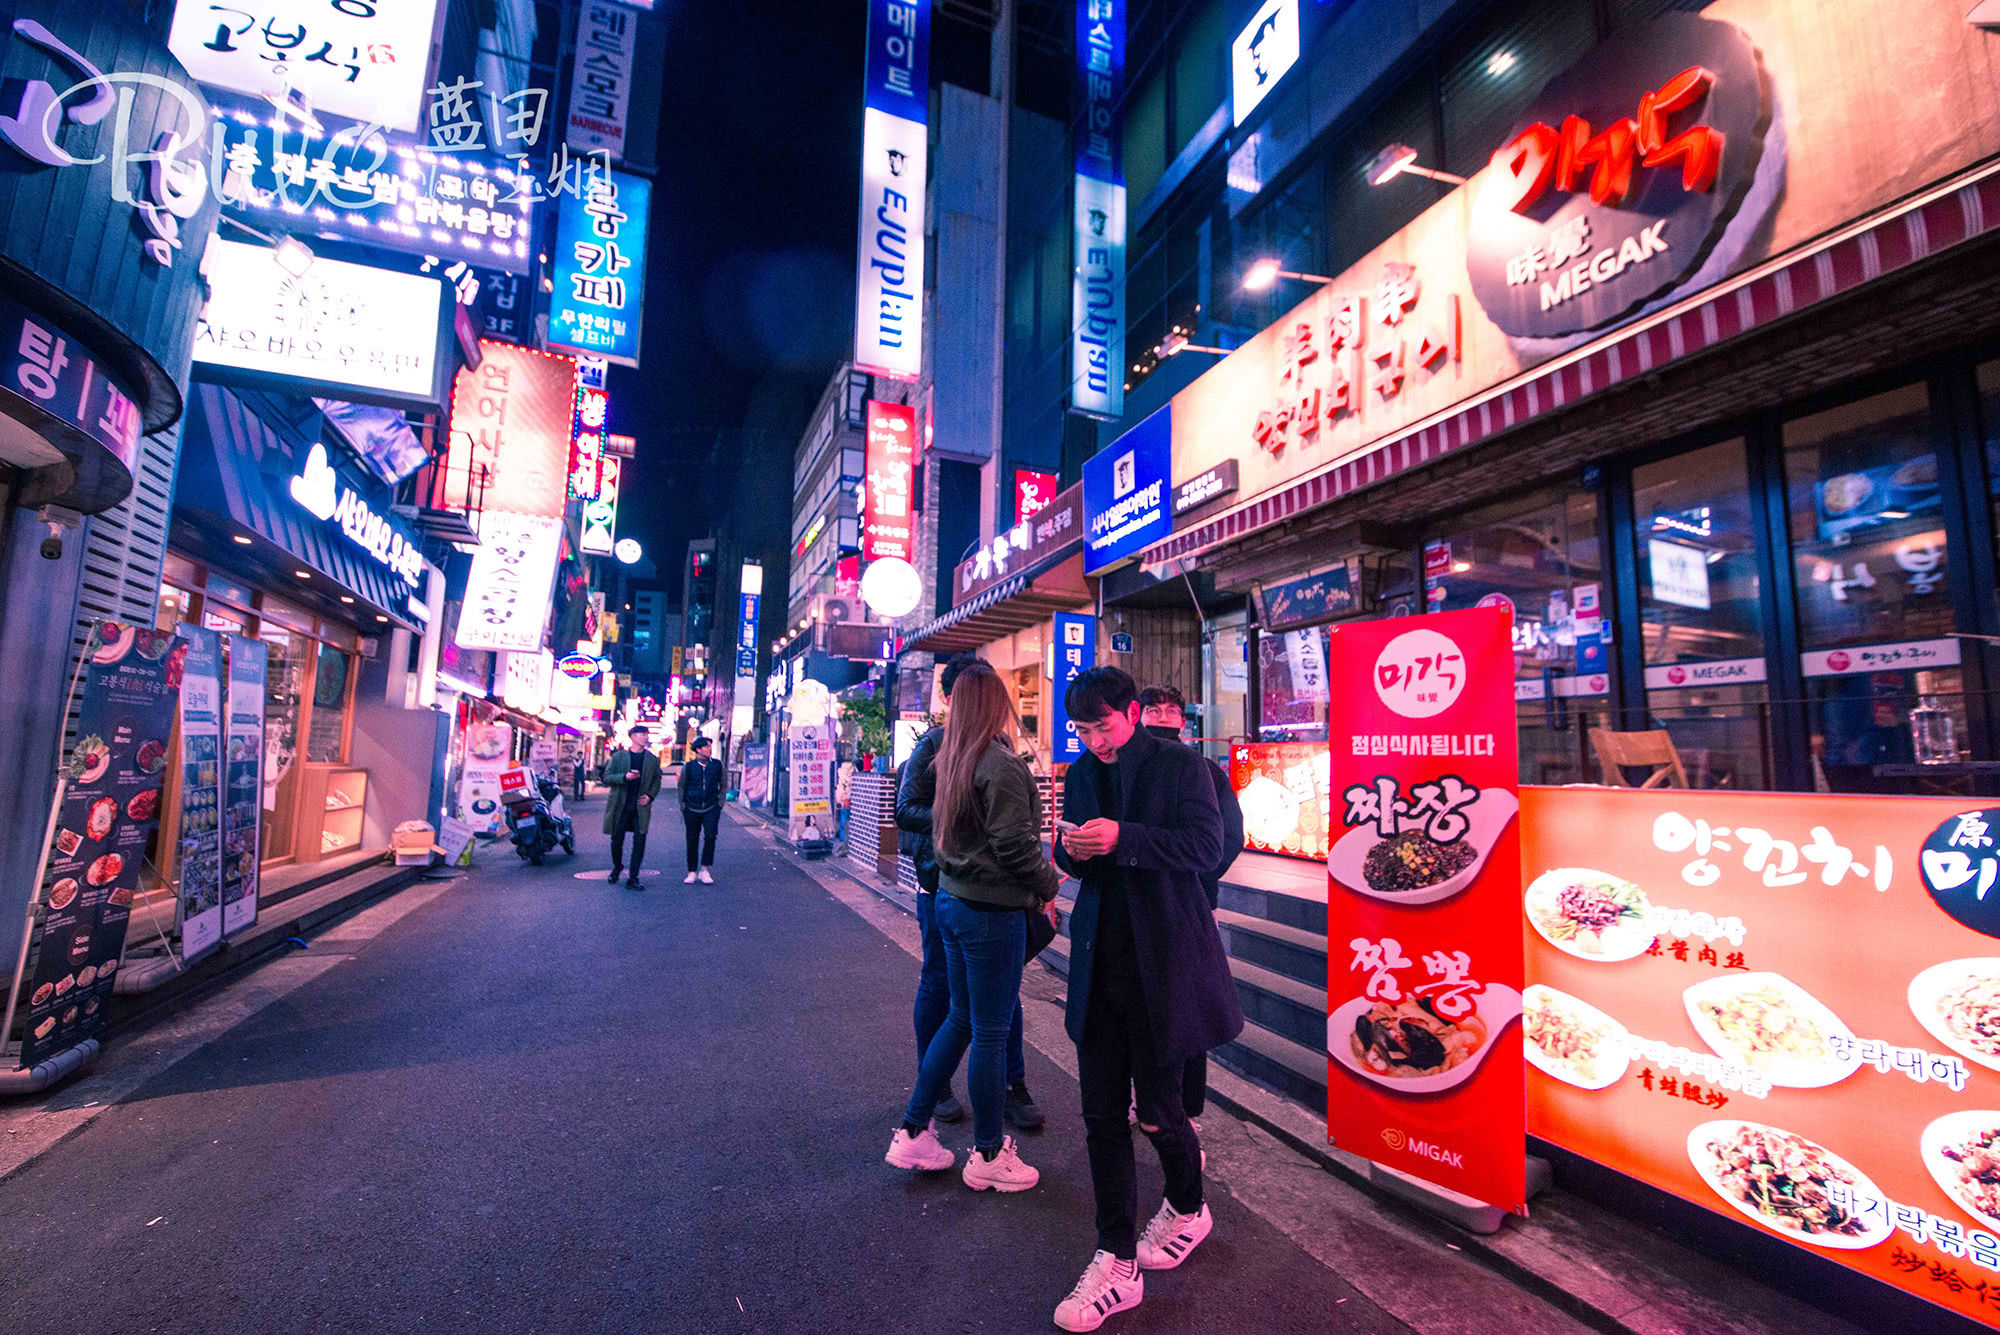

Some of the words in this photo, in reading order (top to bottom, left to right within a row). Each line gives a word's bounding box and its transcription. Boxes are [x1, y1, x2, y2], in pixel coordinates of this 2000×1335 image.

[1488, 65, 1726, 215] 미각
[1540, 219, 1669, 312] MEGAK
[1378, 652, 1461, 693] 미각
[1351, 733, 1495, 757] 점심식사됩니다
[1344, 775, 1480, 845] 짜장
[1948, 811, 1994, 848] 原
[1653, 811, 1893, 892] 양꼬치
[1922, 848, 2000, 900] 미
[1350, 937, 1481, 1017] 짬뽕
[1828, 1032, 1964, 1088] 향라대하
[1408, 1137, 1464, 1169] MIGAK
[1829, 1187, 2000, 1268] 바지락볶음
